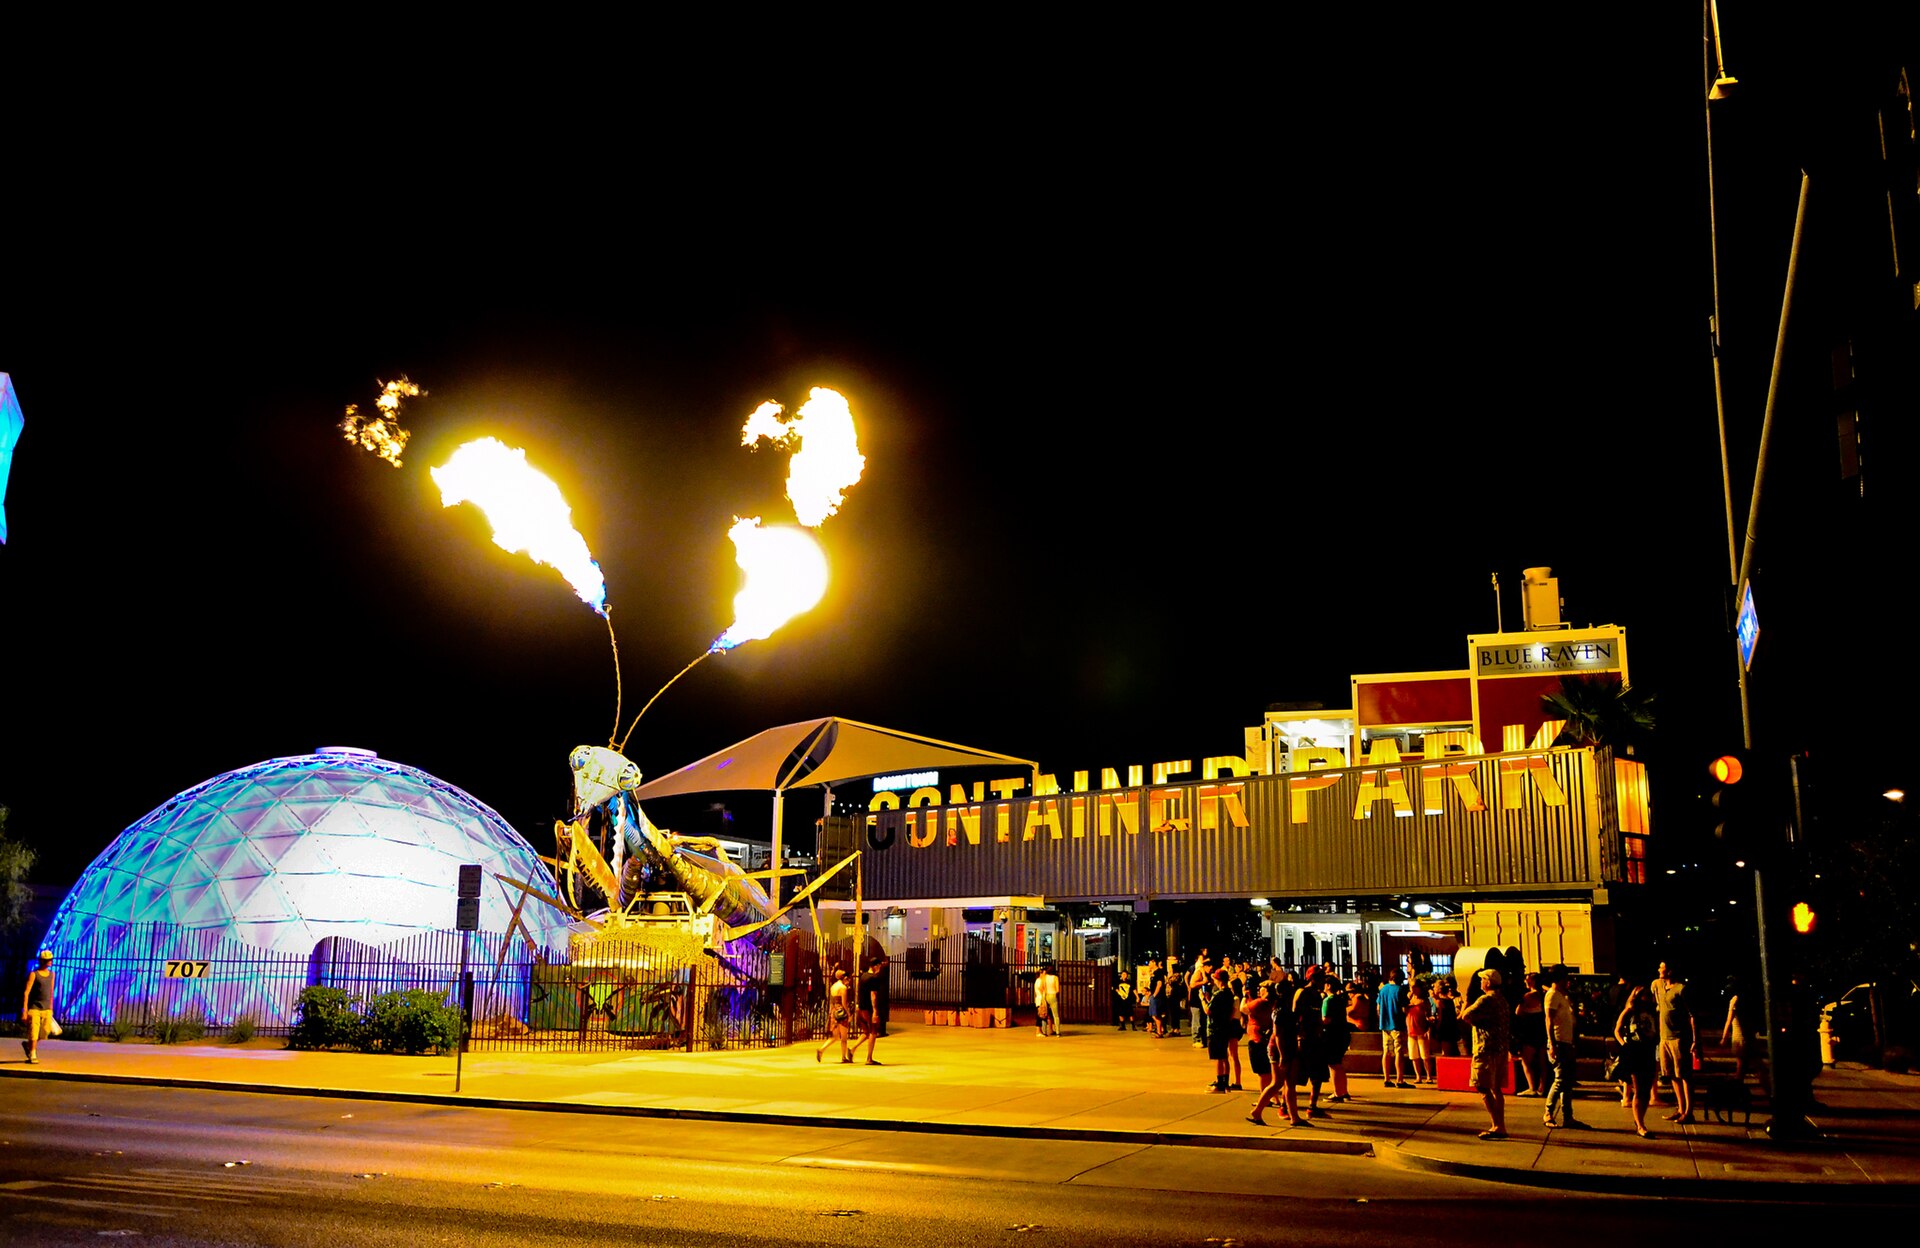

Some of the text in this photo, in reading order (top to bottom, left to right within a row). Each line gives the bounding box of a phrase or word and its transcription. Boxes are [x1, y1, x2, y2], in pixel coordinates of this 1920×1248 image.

[1481, 643, 1611, 667] BLUE RAVEN
[1518, 662, 1575, 671] BOUTIQUE
[866, 719, 1568, 850] CONTAINER PARK
[167, 961, 209, 978] 707
